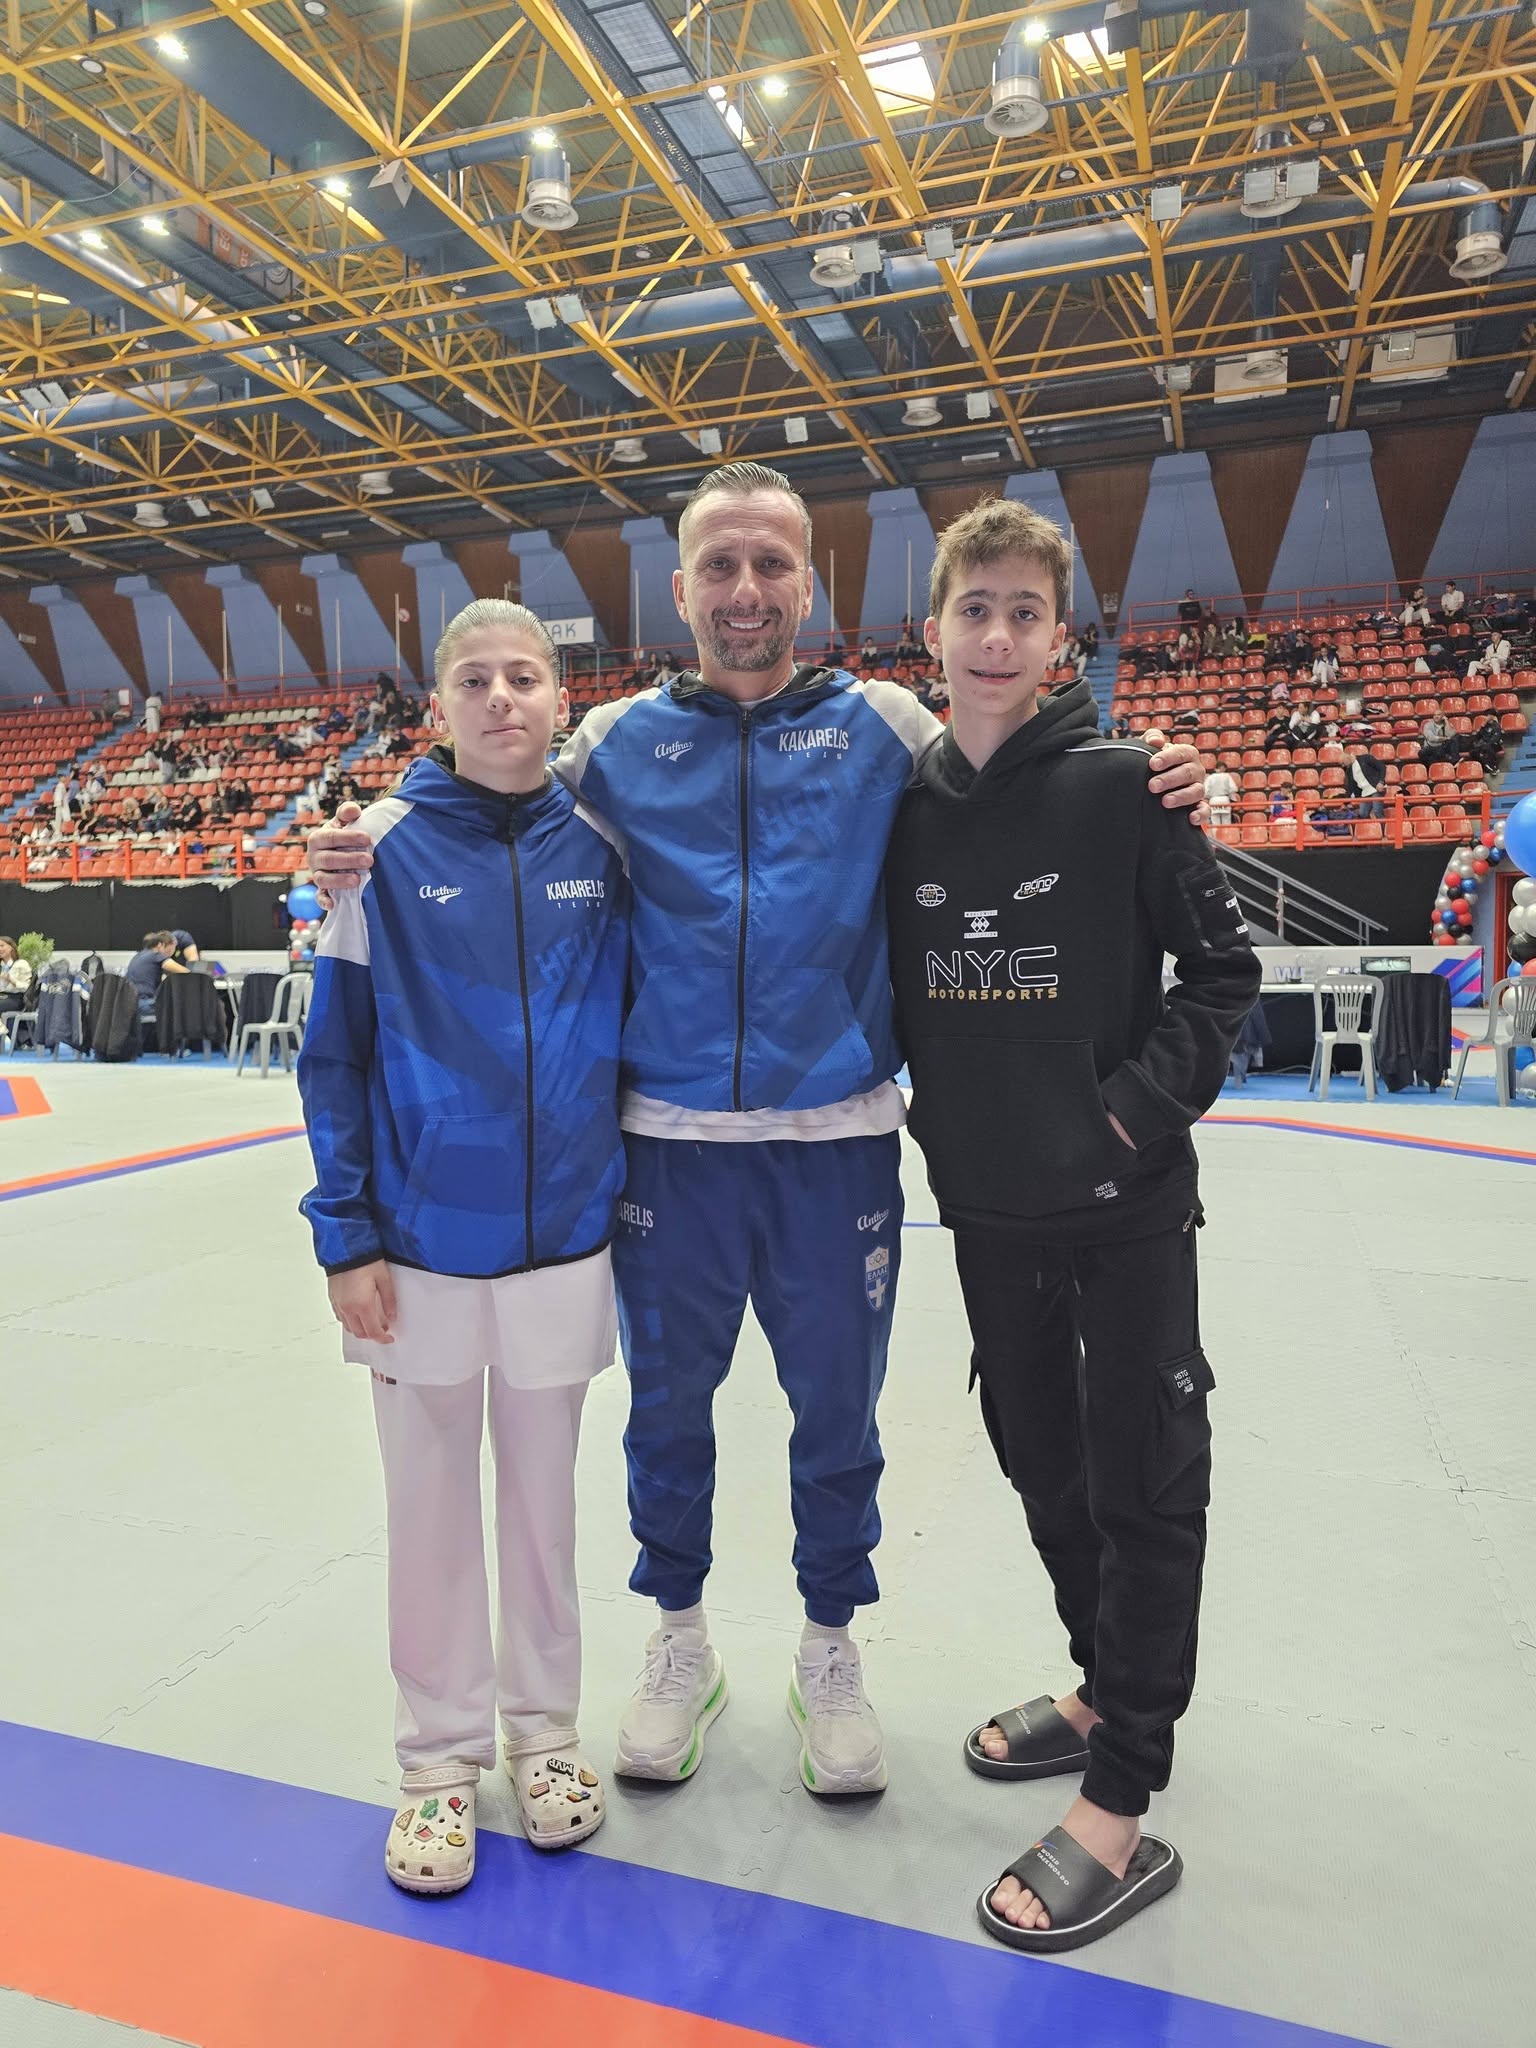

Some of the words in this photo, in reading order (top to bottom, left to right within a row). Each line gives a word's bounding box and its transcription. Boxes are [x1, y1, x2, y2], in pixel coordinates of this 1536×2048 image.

[551, 622, 577, 638] AK
[779, 727, 849, 752] KAKARELIS
[788, 751, 842, 761] TEAM
[545, 879, 605, 901] KAKARELIS
[1021, 878, 1053, 893] racing
[926, 945, 1058, 988] NYC
[928, 987, 1058, 1001] MOTORSPORTS
